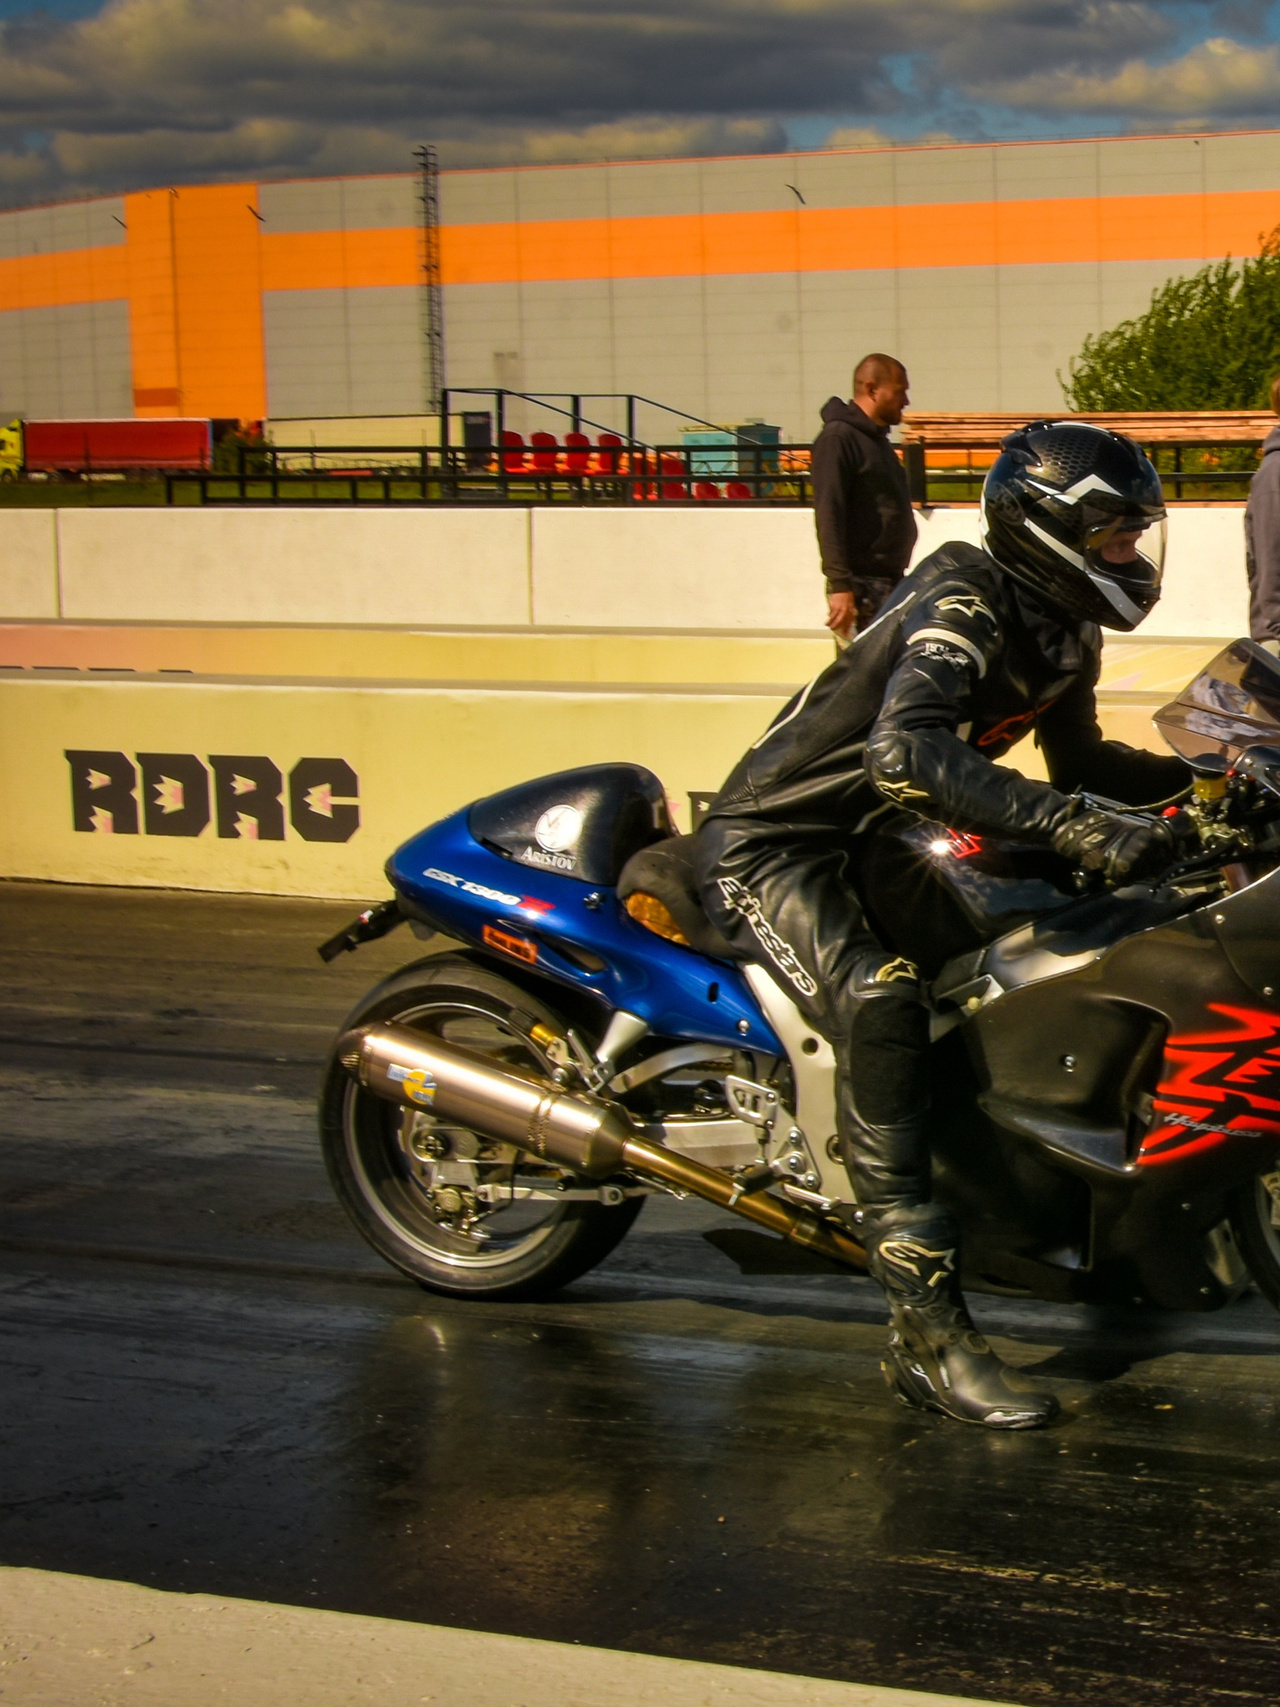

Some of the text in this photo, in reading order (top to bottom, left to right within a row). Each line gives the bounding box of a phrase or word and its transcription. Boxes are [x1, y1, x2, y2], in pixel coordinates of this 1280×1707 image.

[63, 749, 361, 843] RDRC
[423, 868, 464, 887] GSX
[717, 877, 818, 996] alpinestars
[1164, 1113, 1262, 1137] Hayabusa
